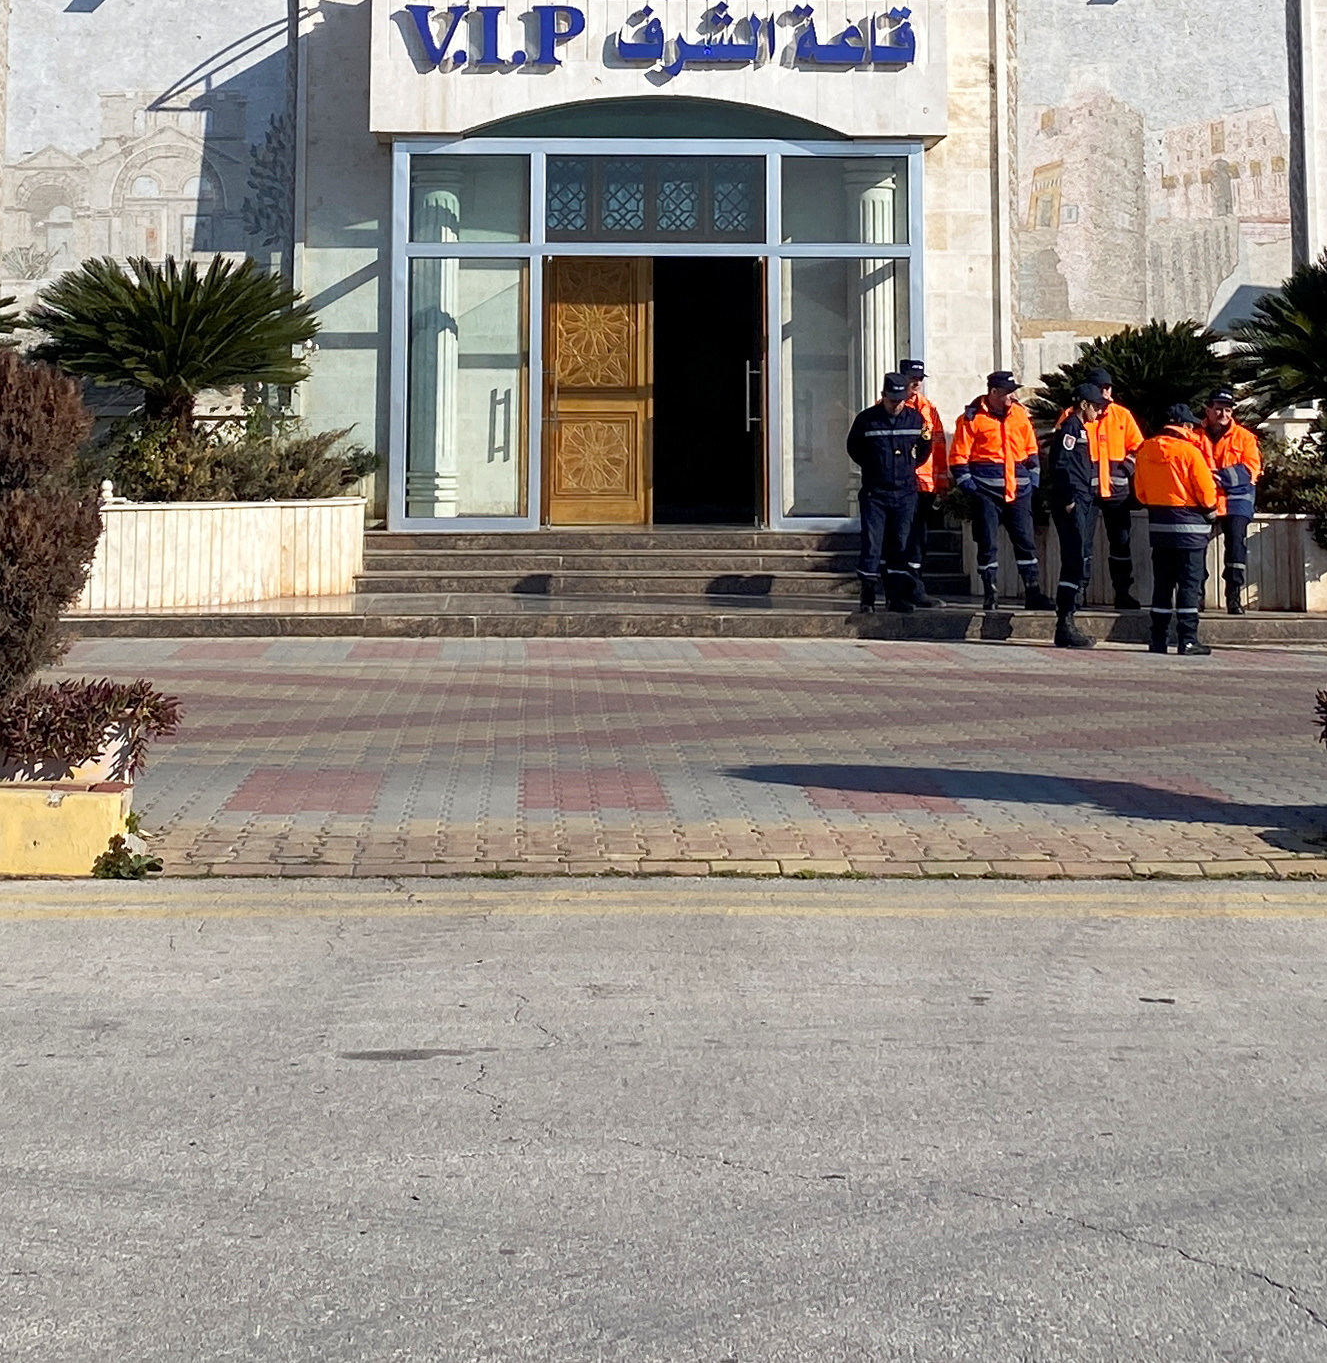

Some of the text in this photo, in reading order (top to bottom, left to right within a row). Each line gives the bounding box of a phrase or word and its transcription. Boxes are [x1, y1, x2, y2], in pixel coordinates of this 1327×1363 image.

[404, 4, 586, 66] V.I.P
[616, 0, 916, 78] قاعة الشرف
